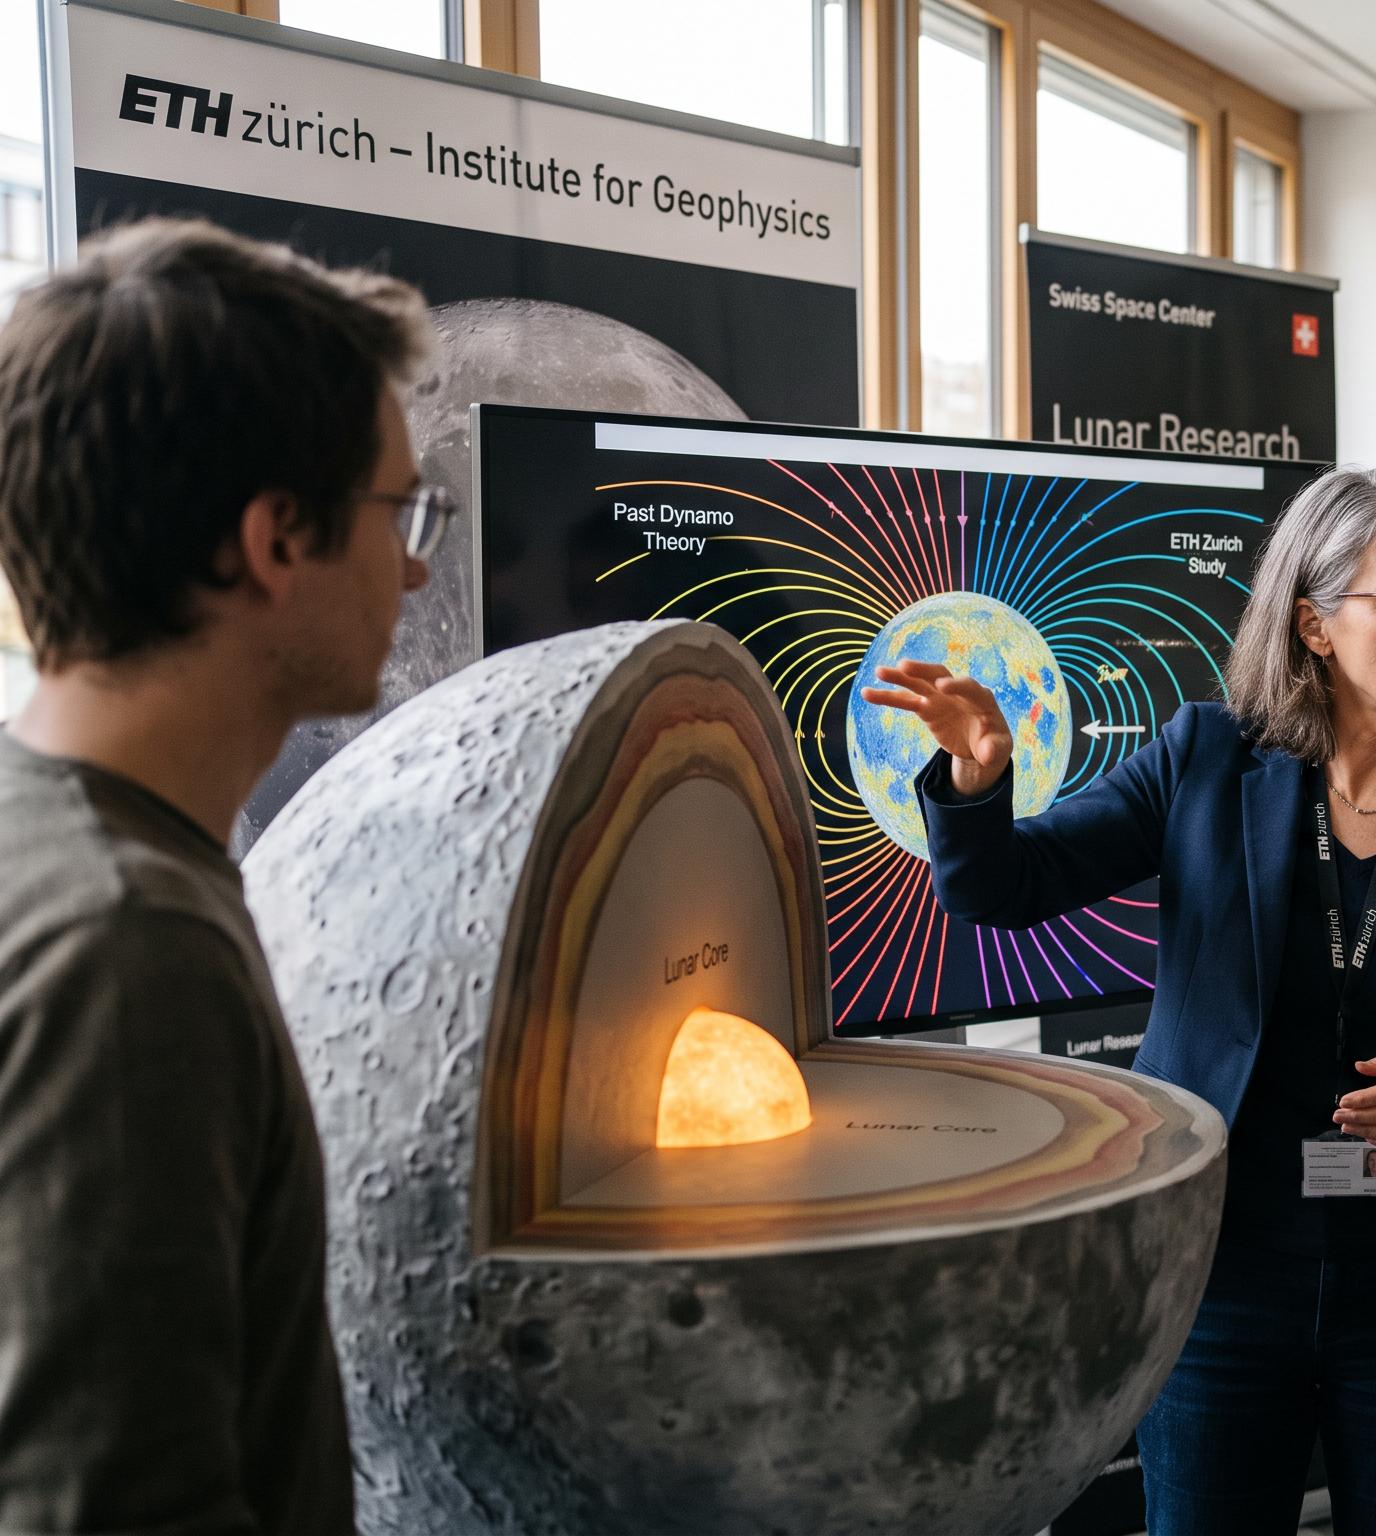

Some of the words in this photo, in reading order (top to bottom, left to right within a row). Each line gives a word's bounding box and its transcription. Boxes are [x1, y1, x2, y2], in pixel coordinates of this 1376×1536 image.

[119, 73, 233, 138] ETH
[242, 102, 376, 163] zürich
[427, 131, 581, 198] Institute
[593, 163, 642, 207] for
[653, 175, 830, 239] Geophysics
[1049, 283, 1100, 313] Swiss
[1104, 291, 1155, 322] Space
[1158, 299, 1216, 328] Center
[1053, 402, 1151, 449] Lunar
[1159, 413, 1300, 460] Research
[613, 502, 655, 522] Past
[660, 504, 734, 528] Dynamo
[643, 531, 706, 555] Theory
[1170, 533, 1200, 550] ETH
[1202, 534, 1243, 552] Zurich
[1188, 557, 1227, 579] Study
[1317, 836, 1330, 860] ETH
[665, 955, 699, 985] Lunar
[702, 942, 729, 969] Core
[1331, 943, 1344, 968] ETH
[1352, 941, 1368, 969] ETH
[1066, 1040, 1101, 1057] Lunar
[846, 1121, 926, 1130] Lunar
[933, 1124, 998, 1133] Core
